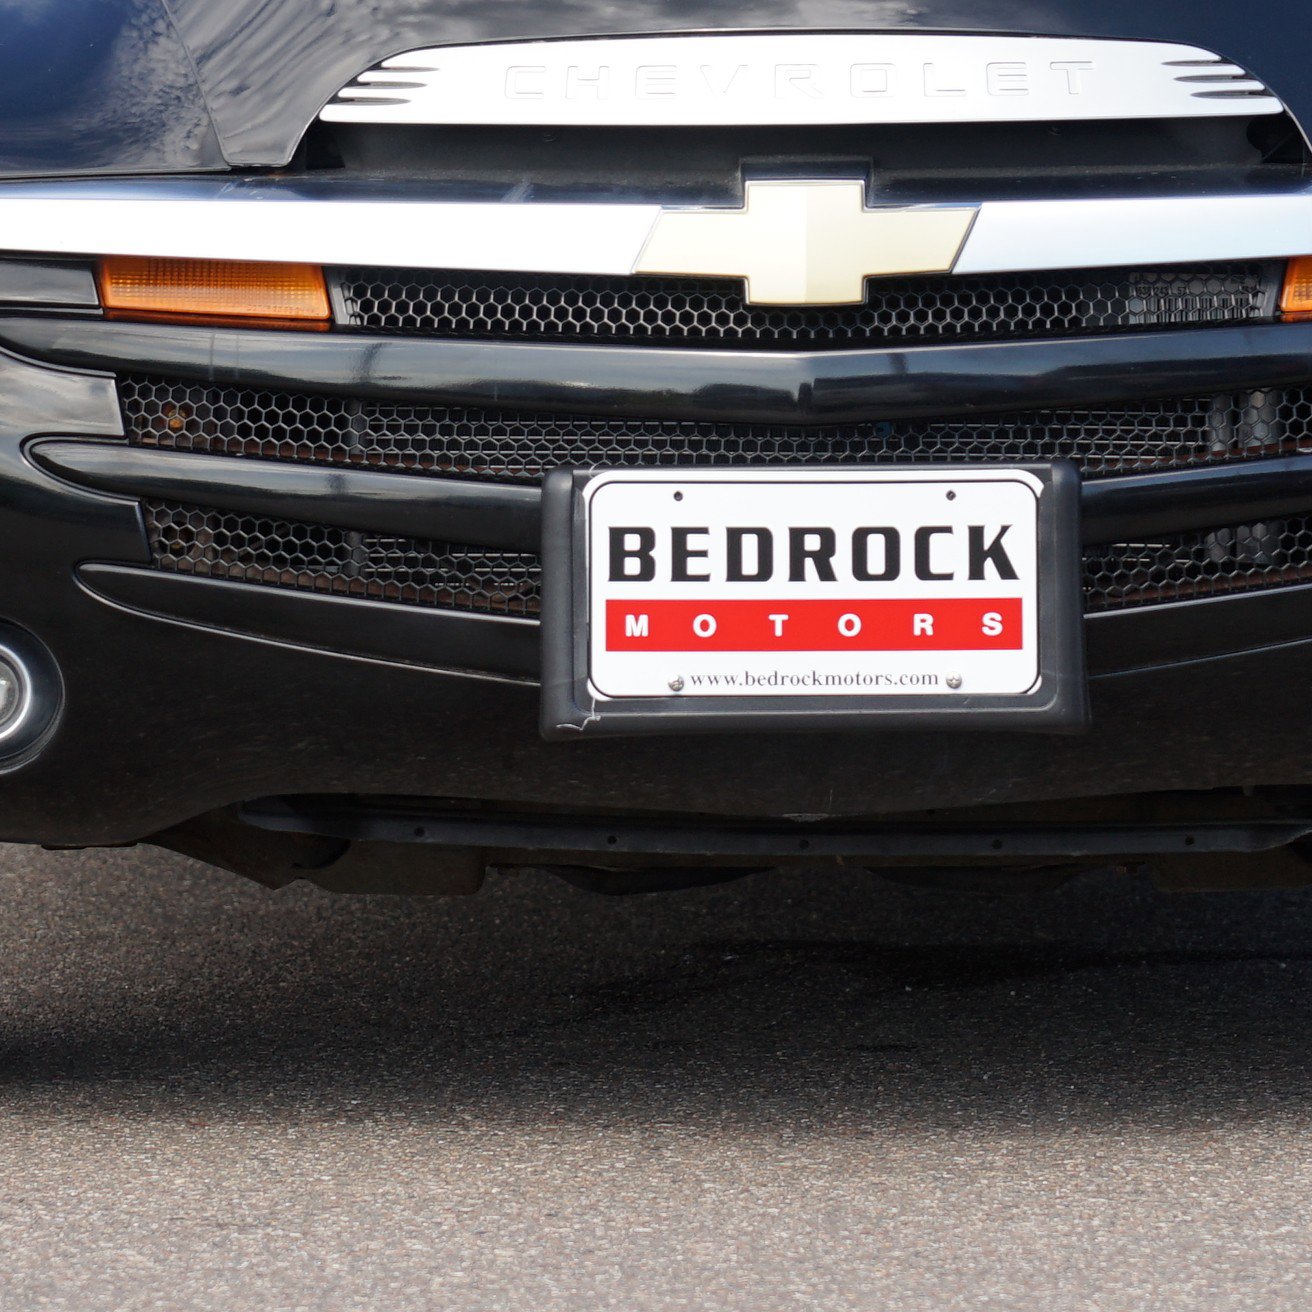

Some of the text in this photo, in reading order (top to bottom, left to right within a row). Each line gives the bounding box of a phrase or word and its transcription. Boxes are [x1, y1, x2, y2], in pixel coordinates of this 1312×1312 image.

[504, 61, 1094, 99] CHEVROLET
[607, 524, 1020, 582] BEDROCK
[624, 612, 1003, 637] MOTORS
[690, 670, 938, 686] www.bedrockmotors.com
